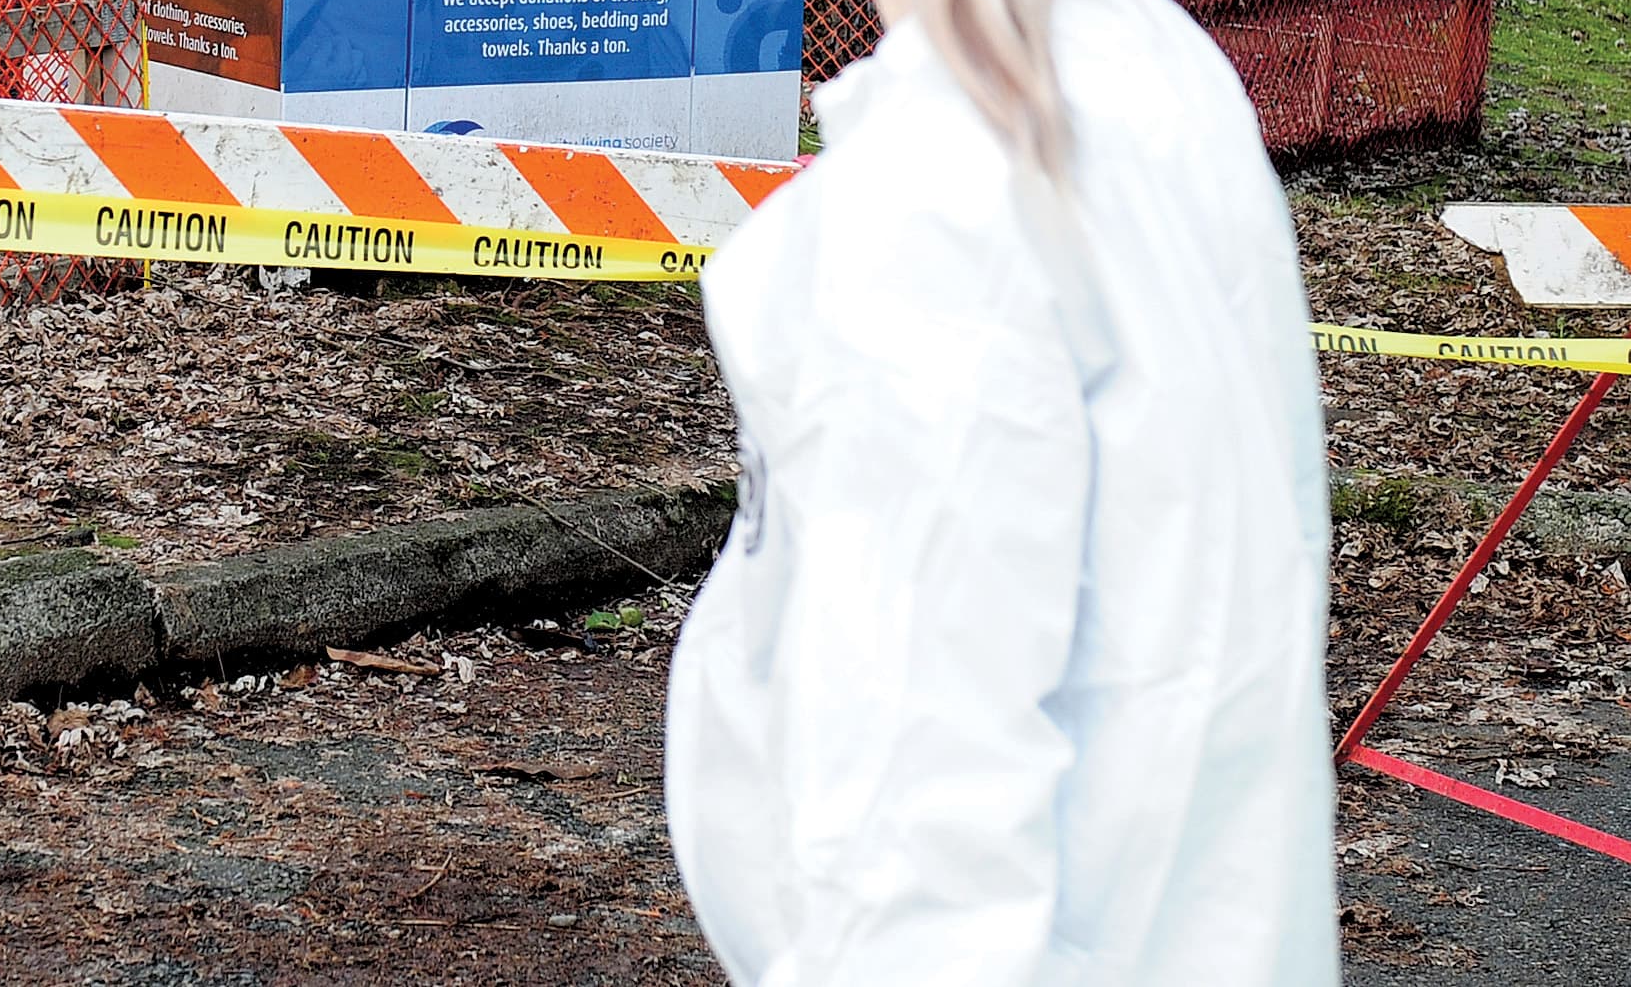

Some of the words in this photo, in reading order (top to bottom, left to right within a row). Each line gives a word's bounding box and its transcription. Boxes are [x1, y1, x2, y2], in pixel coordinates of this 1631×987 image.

[153, 0, 192, 27] clothing,
[194, 12, 248, 39] accessories,
[444, 14, 529, 33] accessories,
[532, 12, 578, 31] shoes,
[581, 11, 639, 31] bedding
[642, 9, 669, 27] and
[178, 32, 210, 54] Thanks
[212, 44, 219, 56] a
[220, 42, 239, 61] ton.
[482, 39, 534, 58] towels.
[538, 38, 587, 56] Thanks
[591, 43, 599, 53] a
[603, 39, 631, 54] ton.
[624, 133, 679, 150] society
[95, 206, 226, 253] CAUTION
[284, 221, 414, 264] CAUTION
[473, 236, 604, 270] CAUTION
